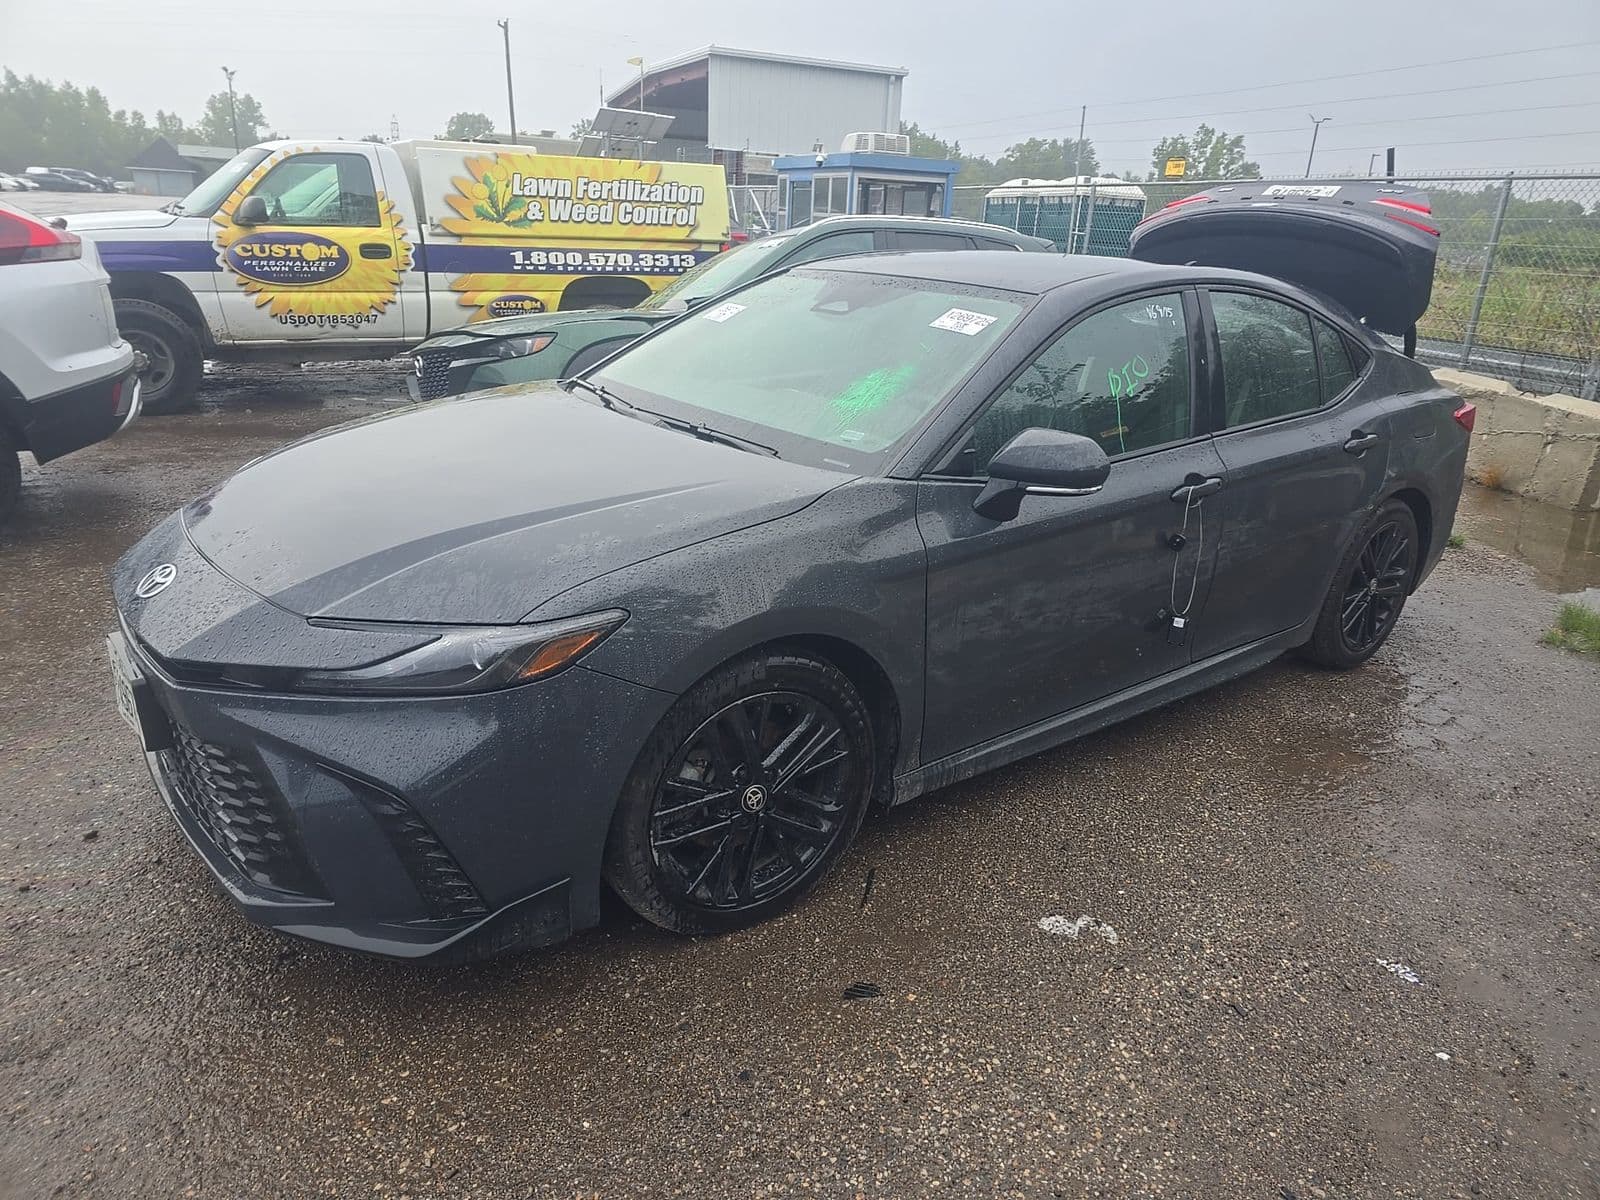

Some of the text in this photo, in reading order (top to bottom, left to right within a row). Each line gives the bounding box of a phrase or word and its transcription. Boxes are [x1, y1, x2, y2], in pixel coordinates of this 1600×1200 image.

[512, 173, 704, 204] Lawn Fertilization
[526, 199, 697, 226] & Weed Control
[234, 242, 340, 261] CUSTOM
[509, 250, 696, 268] 1.800.570.3313
[491, 299, 542, 310] CUSTOM
[279, 313, 379, 325] USDOT1853047
